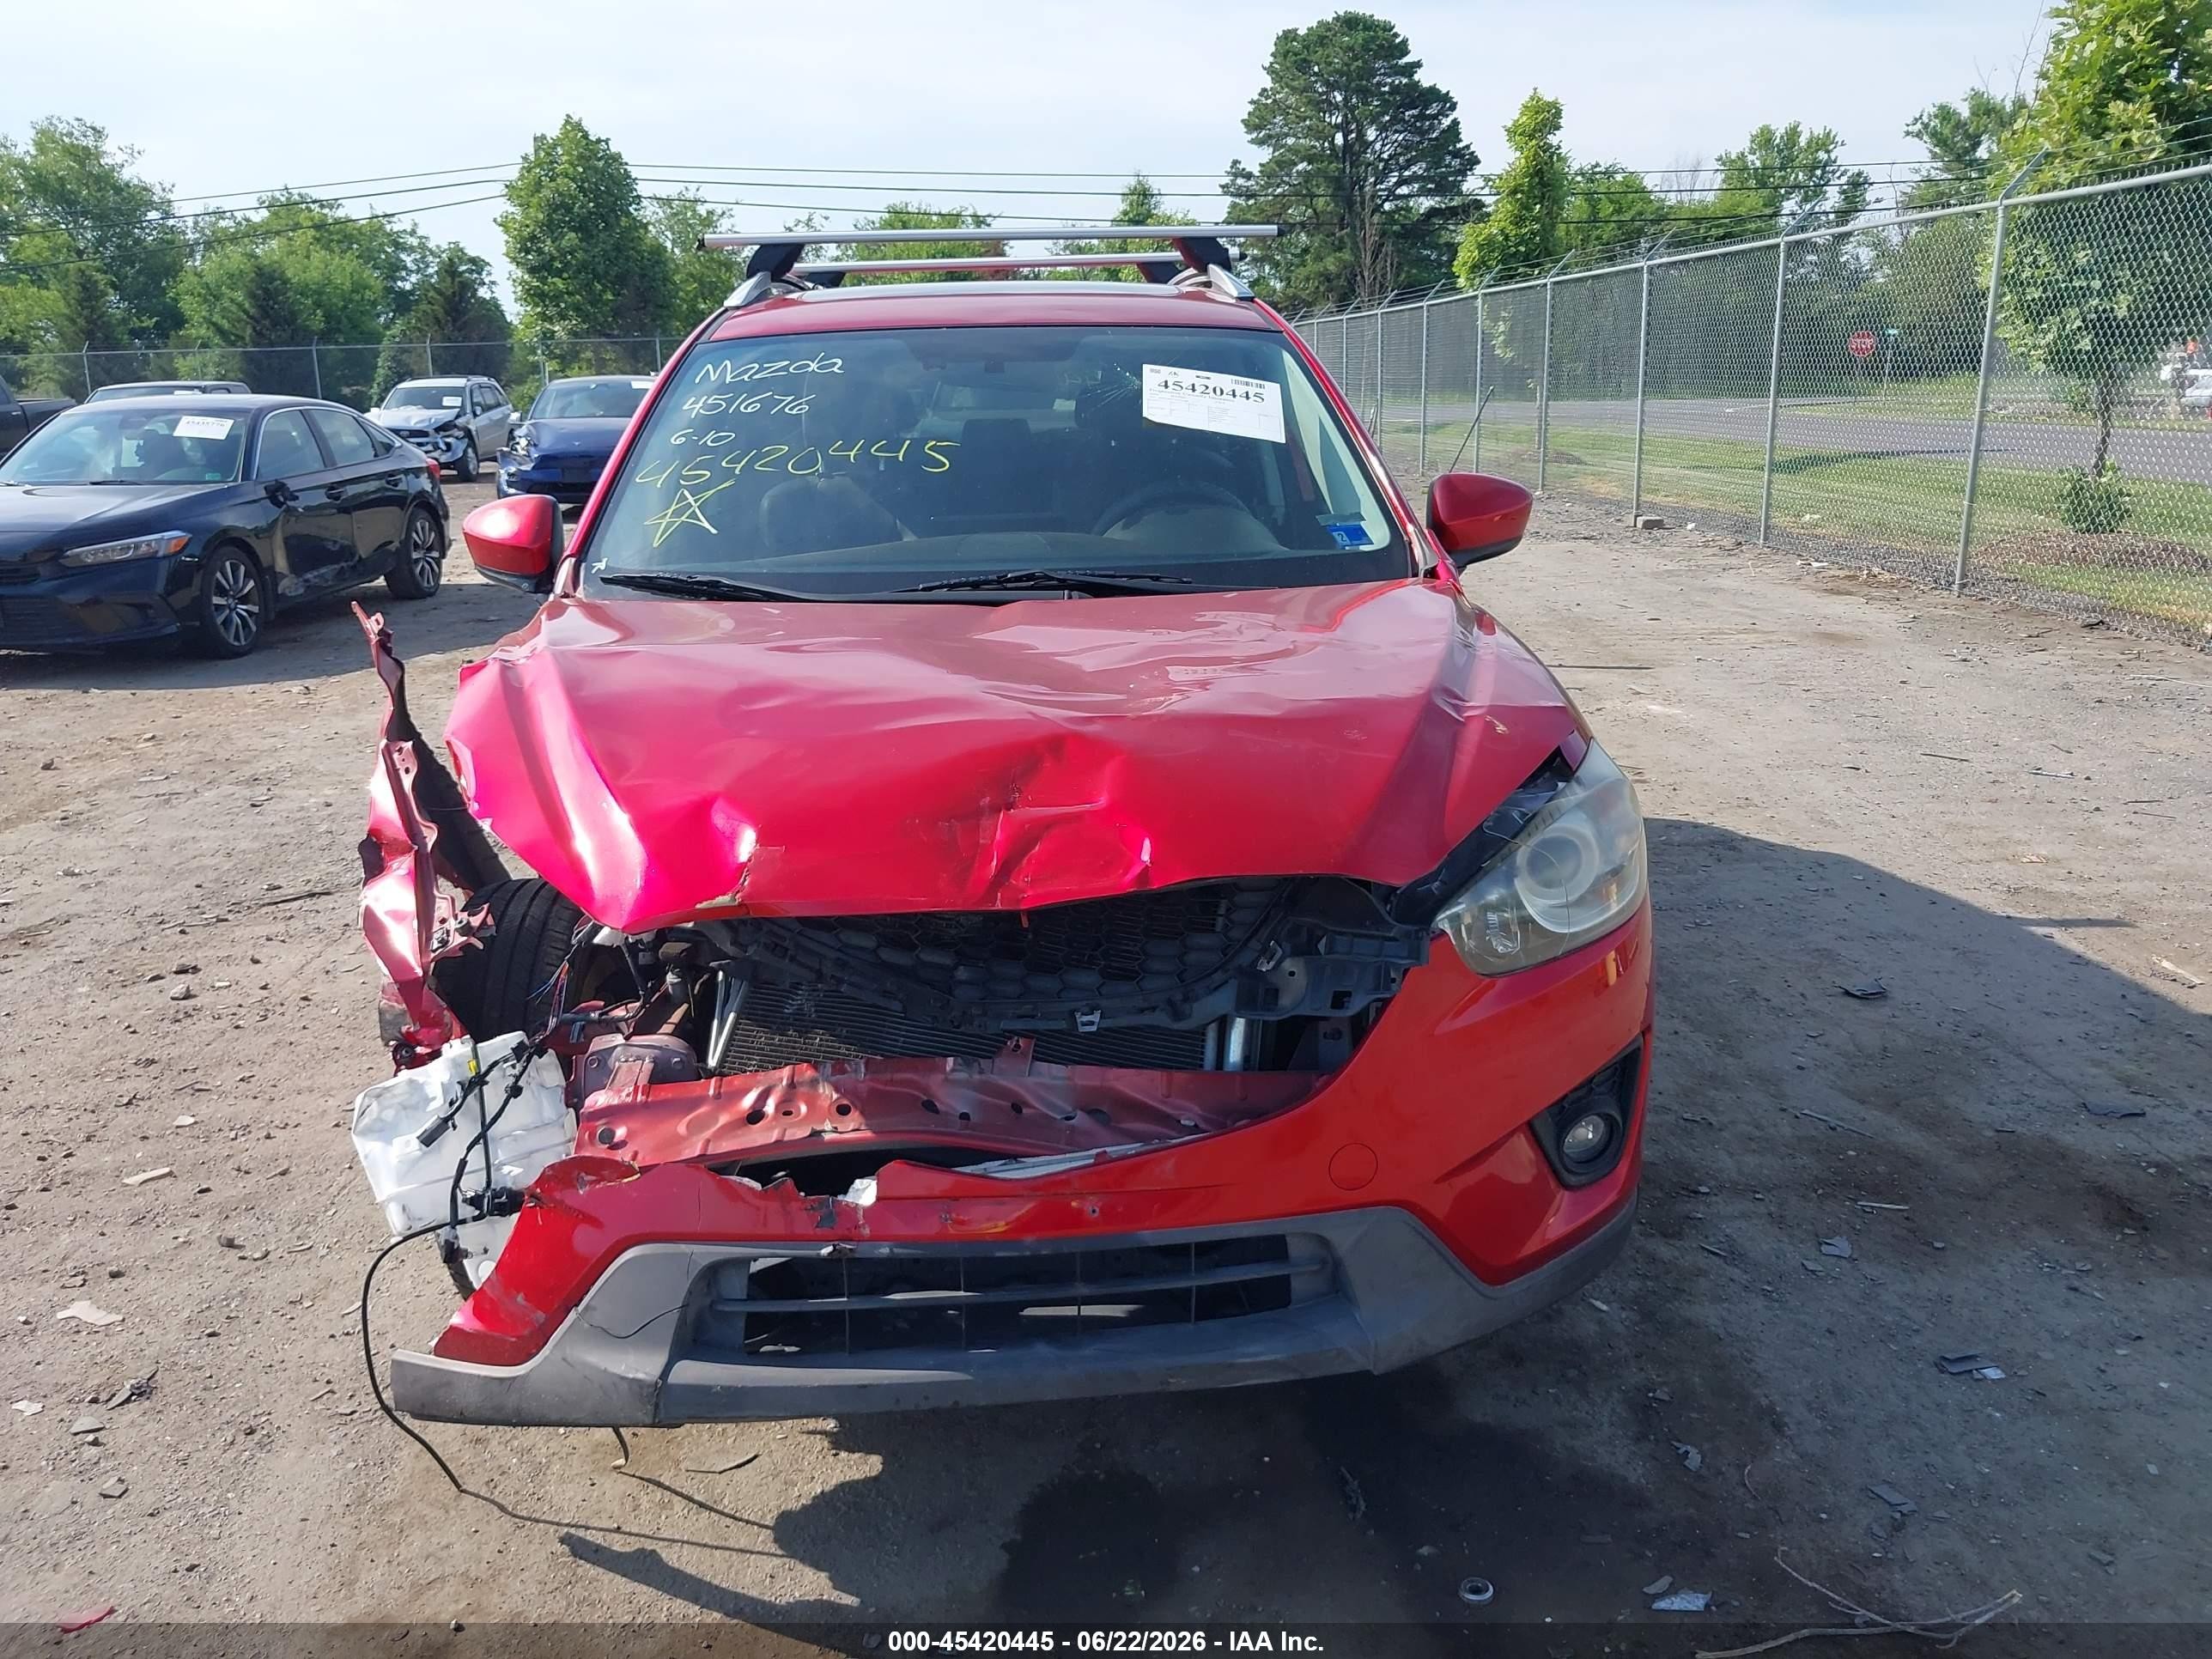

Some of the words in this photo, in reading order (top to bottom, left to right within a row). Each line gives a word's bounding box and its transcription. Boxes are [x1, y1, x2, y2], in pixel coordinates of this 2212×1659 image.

[1850, 337, 1874, 349] STOP
[695, 352, 845, 385] Mazda
[1158, 380, 1265, 403] 45420445
[683, 392, 817, 418] 451676
[670, 429, 736, 448] 6-10
[635, 439, 961, 489] 45420445
